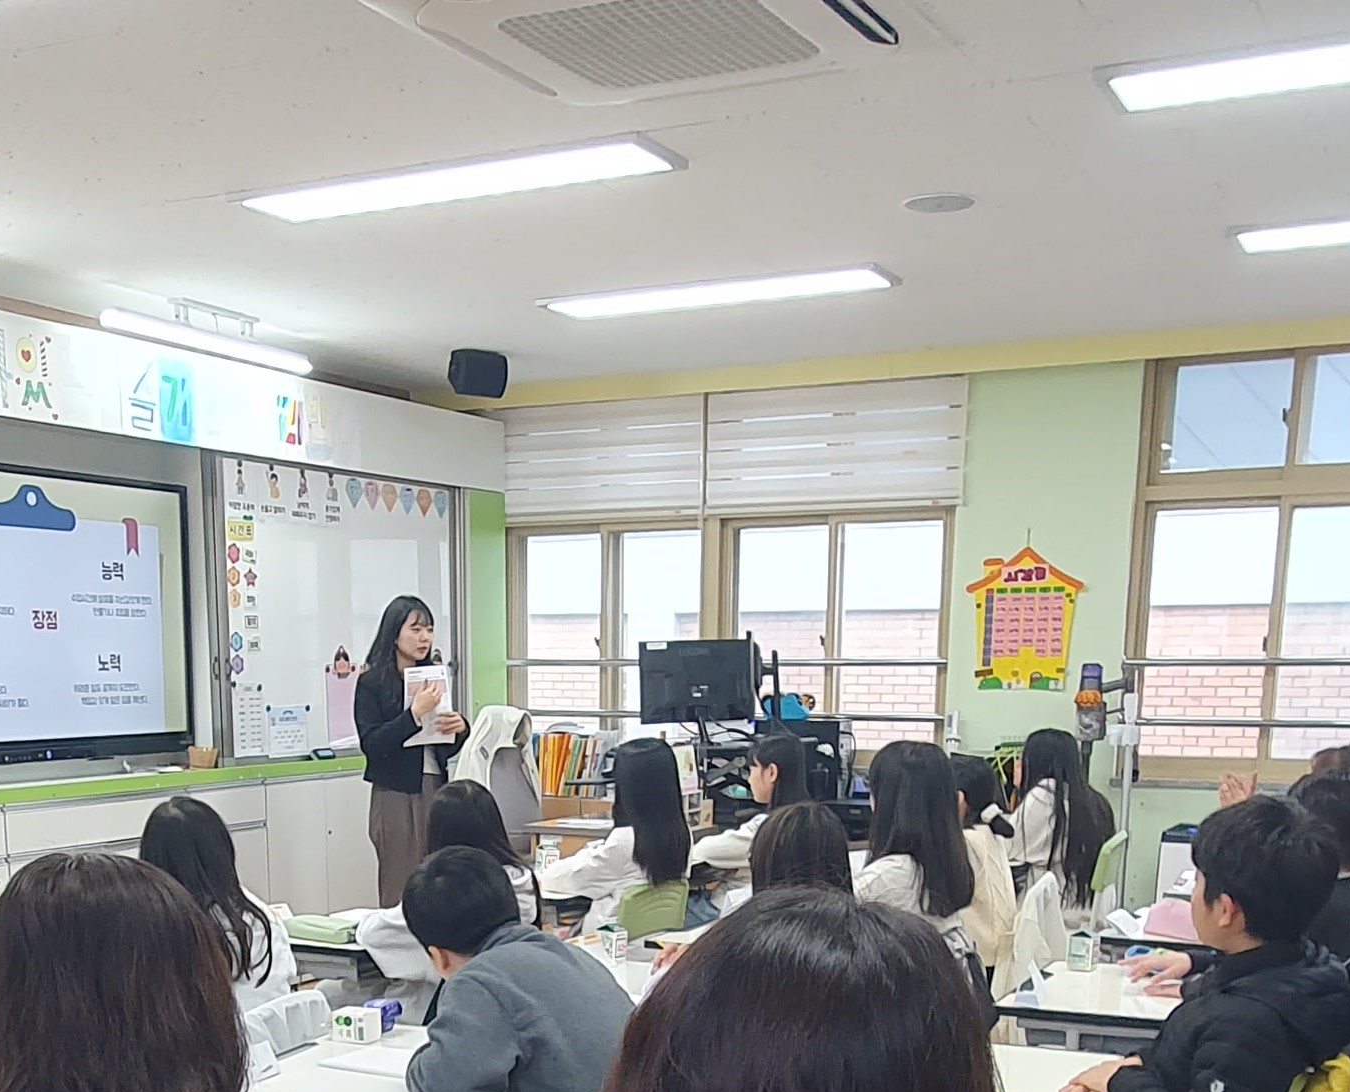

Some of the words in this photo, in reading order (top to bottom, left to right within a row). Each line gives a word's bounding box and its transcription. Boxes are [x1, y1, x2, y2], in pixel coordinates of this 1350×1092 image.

[230, 525, 252, 536] 시간표
[101, 561, 124, 581] 능력
[32, 610, 58, 630] 장점
[98, 654, 121, 672] 노력
